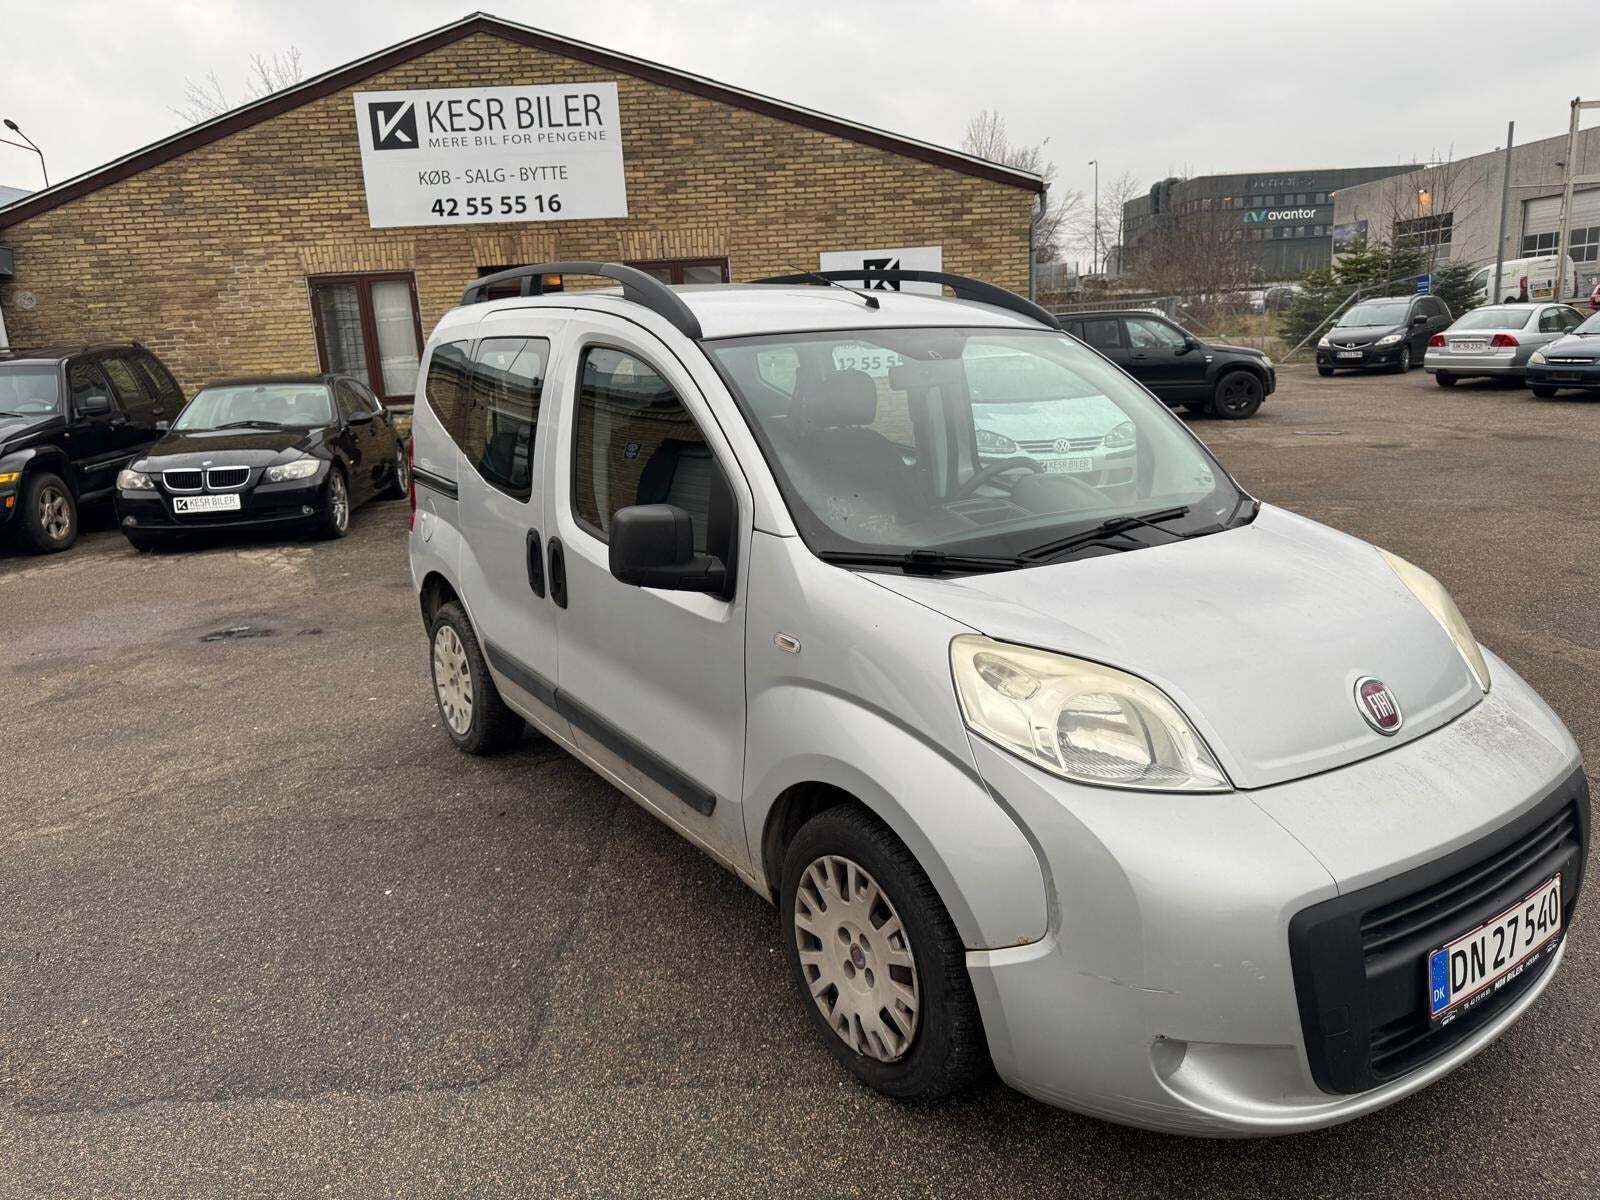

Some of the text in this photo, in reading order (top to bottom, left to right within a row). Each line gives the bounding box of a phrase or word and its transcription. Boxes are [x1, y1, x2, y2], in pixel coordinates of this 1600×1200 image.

[426, 94, 602, 133] KESR BILER
[428, 131, 607, 148] MERE BIL FOR PENGENE
[418, 169, 451, 186] KØB
[465, 167, 506, 184] SALG
[519, 165, 568, 182] BYTTE
[431, 194, 562, 217] 42 55 55 16
[1267, 208, 1316, 221] avantor
[861, 357, 881, 370] 55
[189, 498, 210, 507] KESR
[212, 496, 236, 506] BILER
[1366, 690, 1395, 720] FIAT
[1451, 887, 1558, 995] DN 27 540
[1433, 987, 1445, 1002] DK
